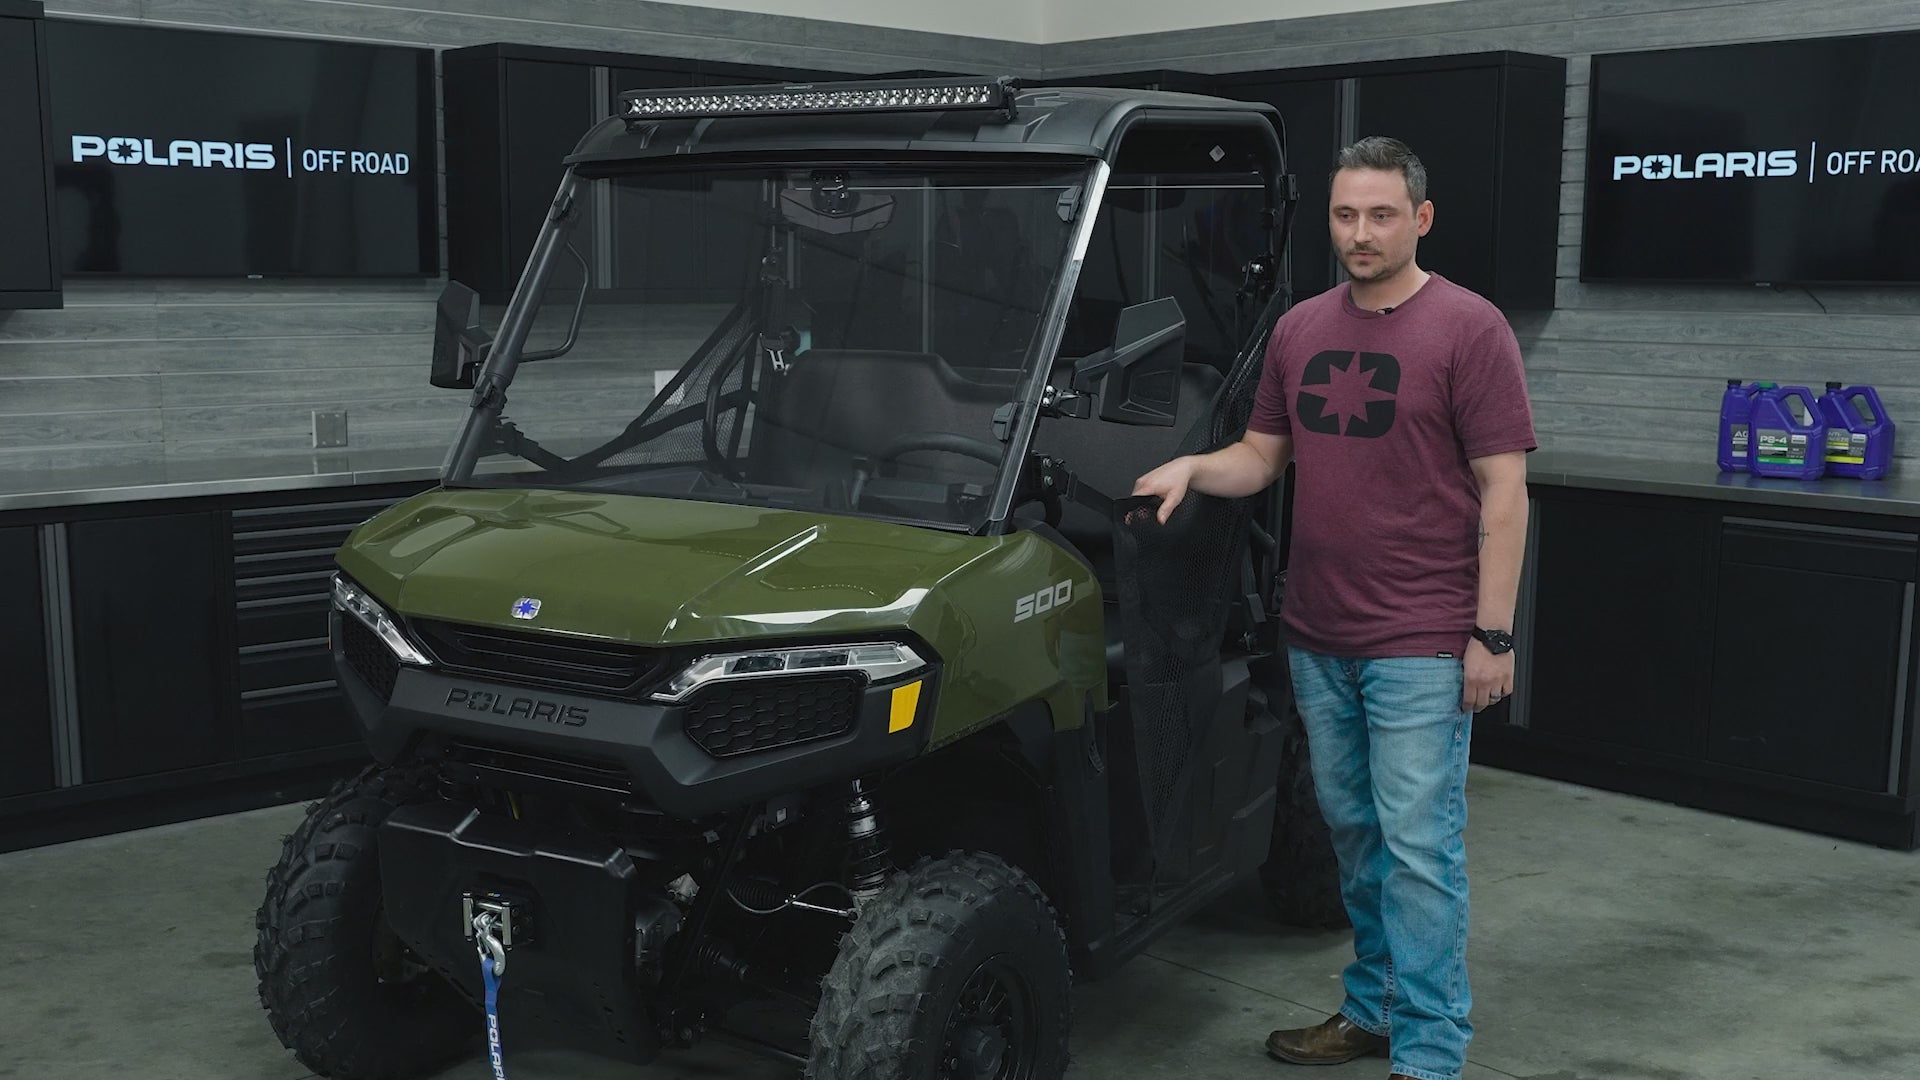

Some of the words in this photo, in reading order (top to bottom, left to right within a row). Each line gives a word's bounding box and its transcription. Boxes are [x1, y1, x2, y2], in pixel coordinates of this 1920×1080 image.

[72, 135, 276, 169] POLARIS
[302, 149, 346, 173] OFF
[351, 150, 410, 175] ROAD
[1613, 150, 1798, 180] POLARIS
[1826, 151, 1876, 175] OFF
[1014, 579, 1072, 623] 500
[444, 687, 590, 728] POLARIS
